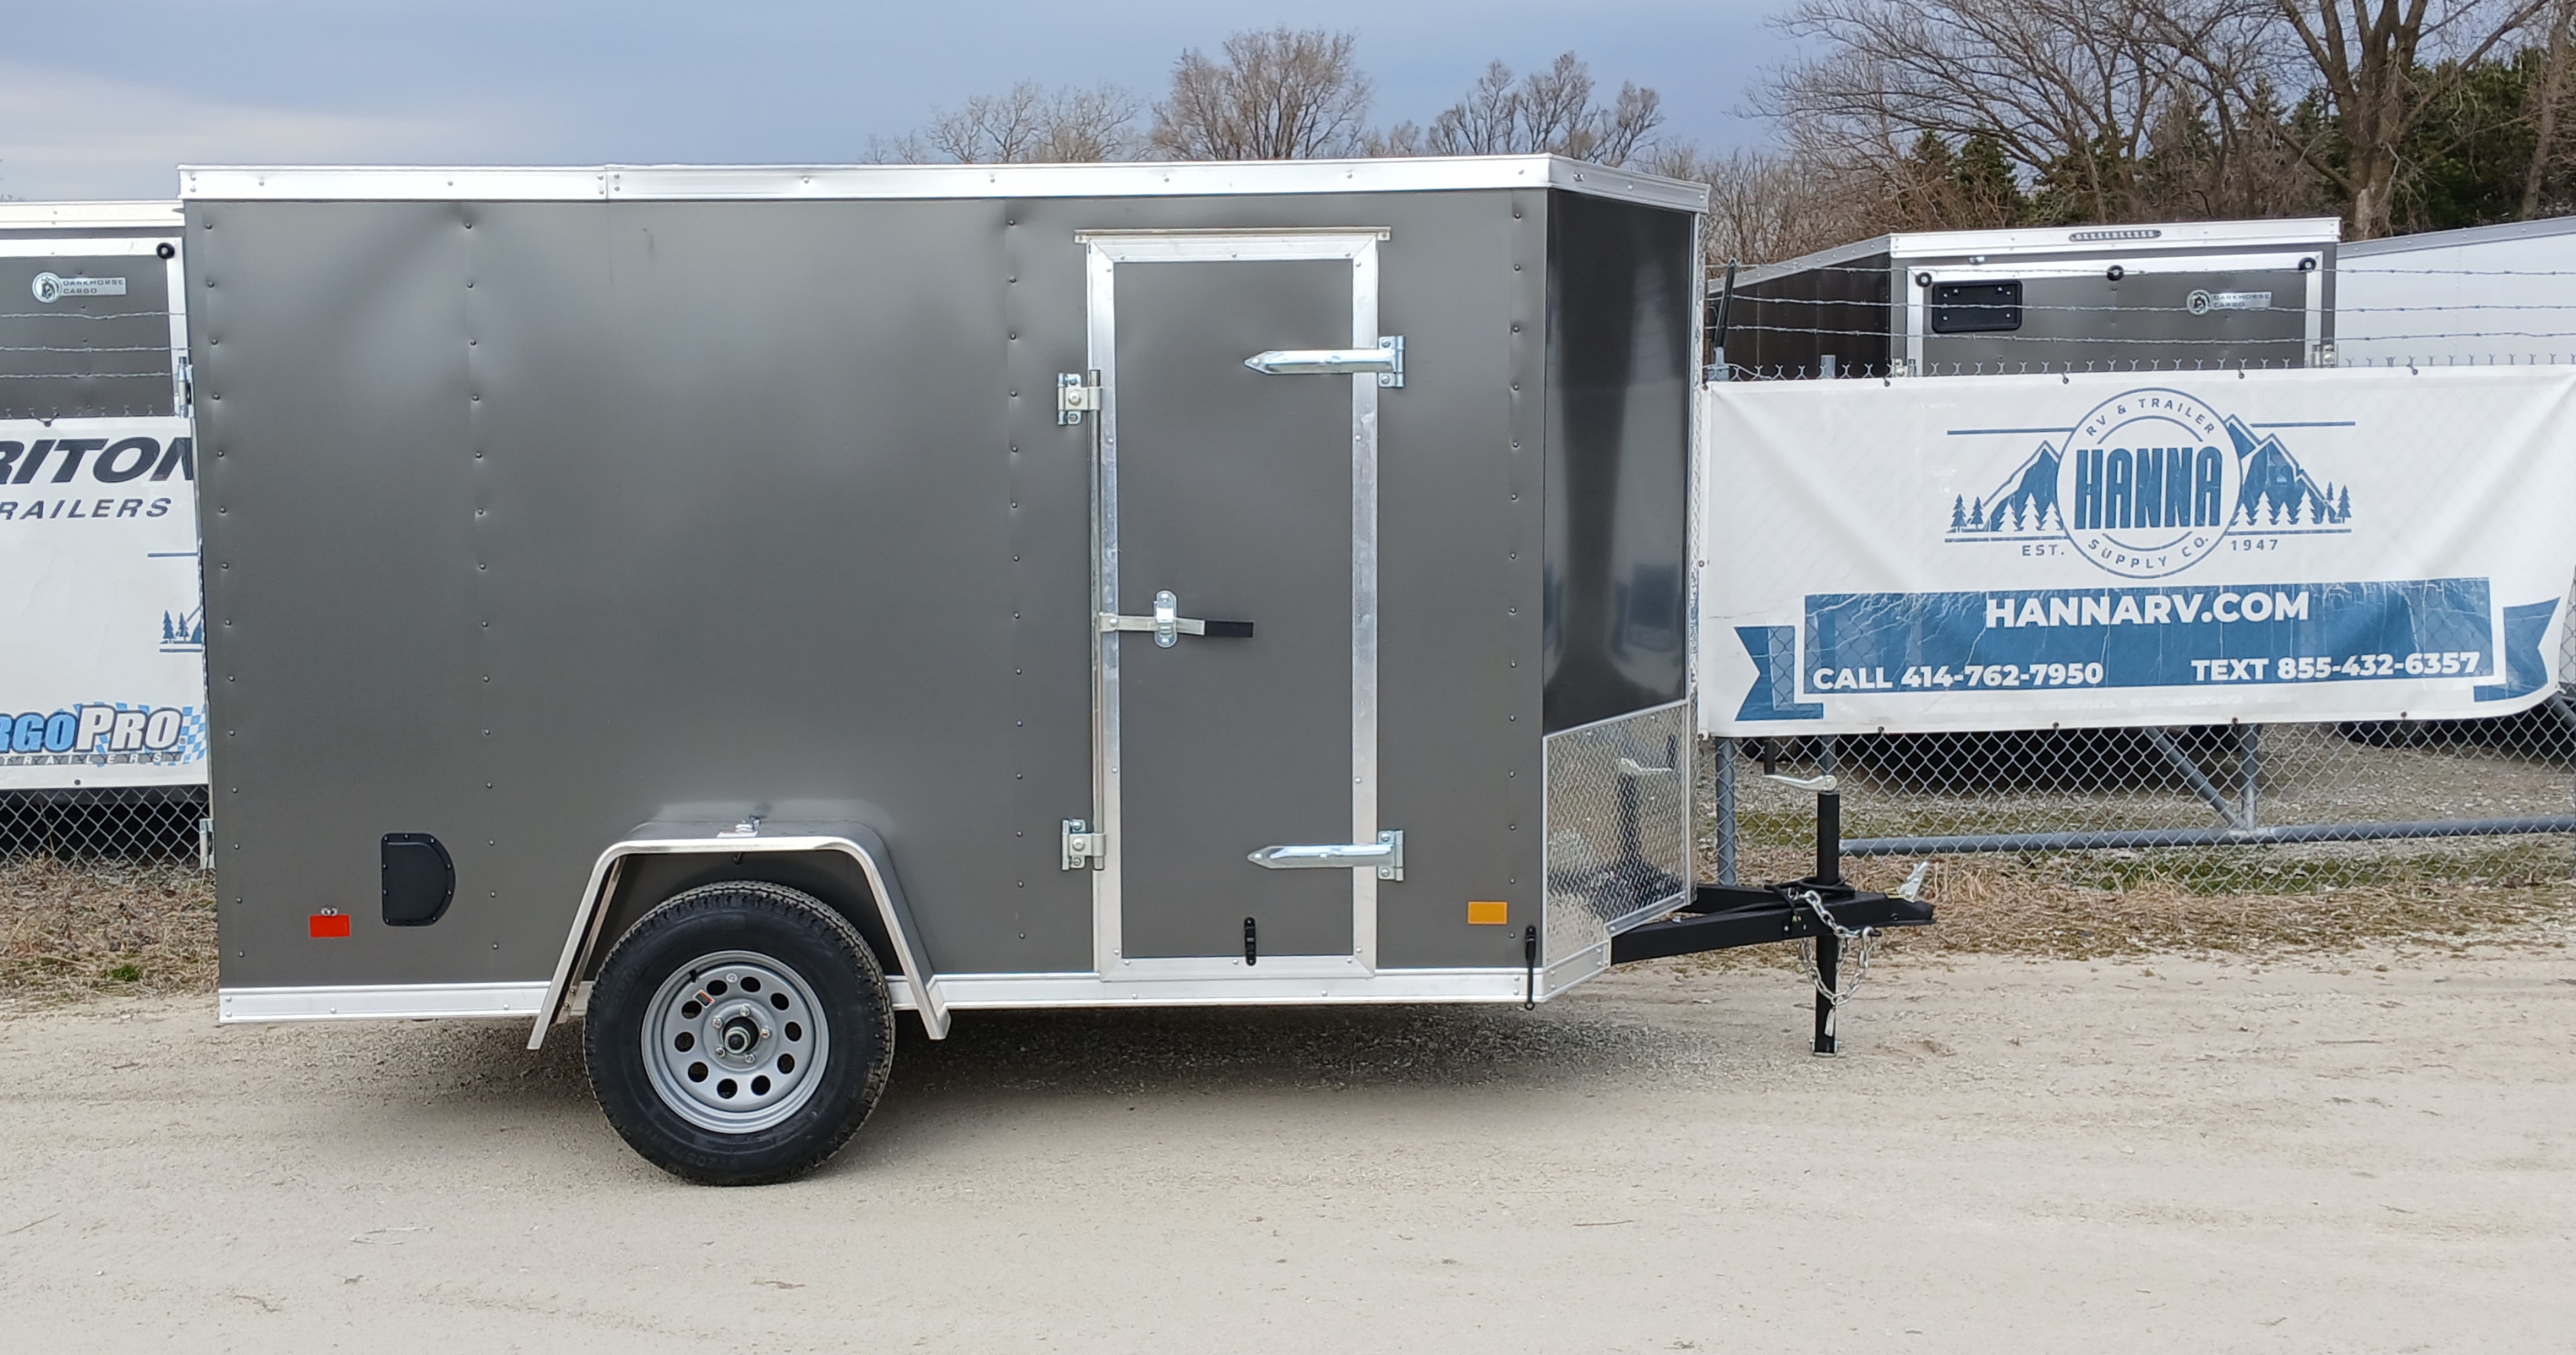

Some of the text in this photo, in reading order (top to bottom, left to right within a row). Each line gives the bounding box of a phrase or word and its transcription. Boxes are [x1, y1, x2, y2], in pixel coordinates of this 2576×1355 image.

[2086, 398, 2215, 436] RV & TRAILER
[2074, 446, 2223, 530] HANNA
[2022, 544, 2065, 556] EST.
[2088, 537, 2209, 568] SUPPLY CO.
[2230, 539, 2278, 551] 1947
[1985, 591, 2310, 629] HANNARV.COM
[1813, 662, 2104, 690] CALL 414-762-7950
[2190, 651, 2480, 682] TEXT 855-432-6357
[3, 753, 163, 766] TRAILERS
